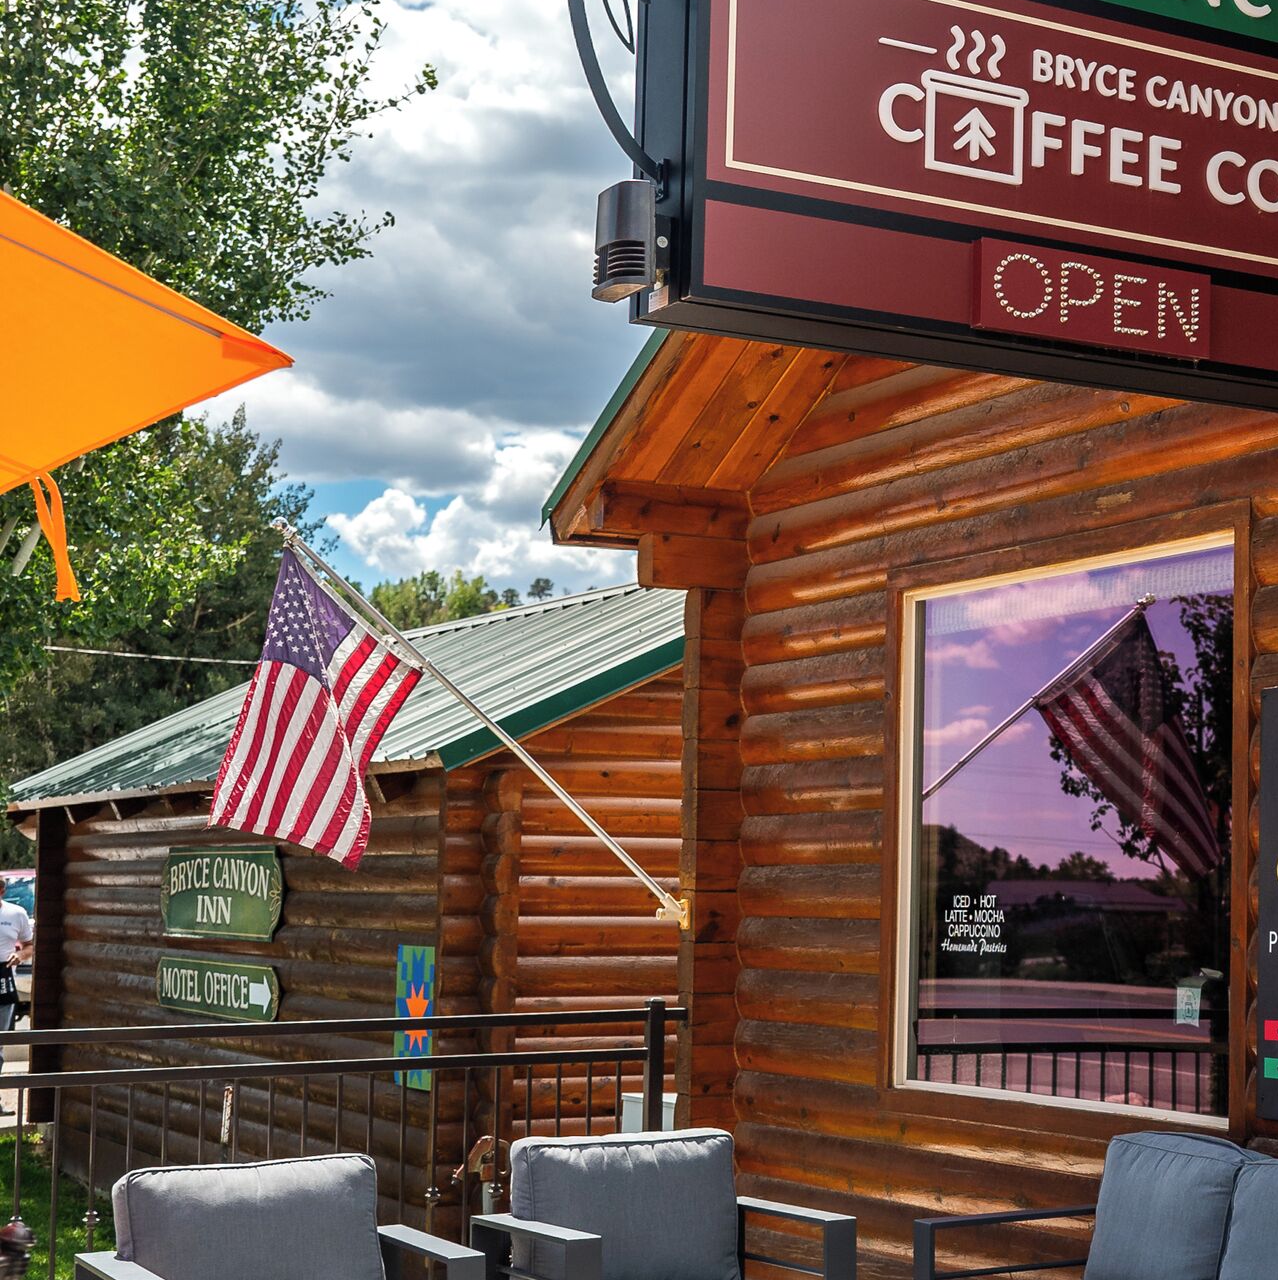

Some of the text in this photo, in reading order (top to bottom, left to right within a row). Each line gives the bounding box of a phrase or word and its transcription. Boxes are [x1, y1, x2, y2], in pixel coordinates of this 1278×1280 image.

[1031, 49, 1136, 103] BRYCE
[994, 253, 1200, 342] OPEN
[170, 857, 270, 900] BRYCE CANYON
[196, 895, 232, 924] INN
[953, 894, 971, 908] ICED
[980, 894, 997, 908] HOT
[945, 909, 1005, 923] LATTE MOCHA
[948, 924, 1001, 937] CAPPUCCINO
[941, 938, 1008, 956] Homemade Pastries
[162, 967, 249, 1009] MOTEL OFFICE
